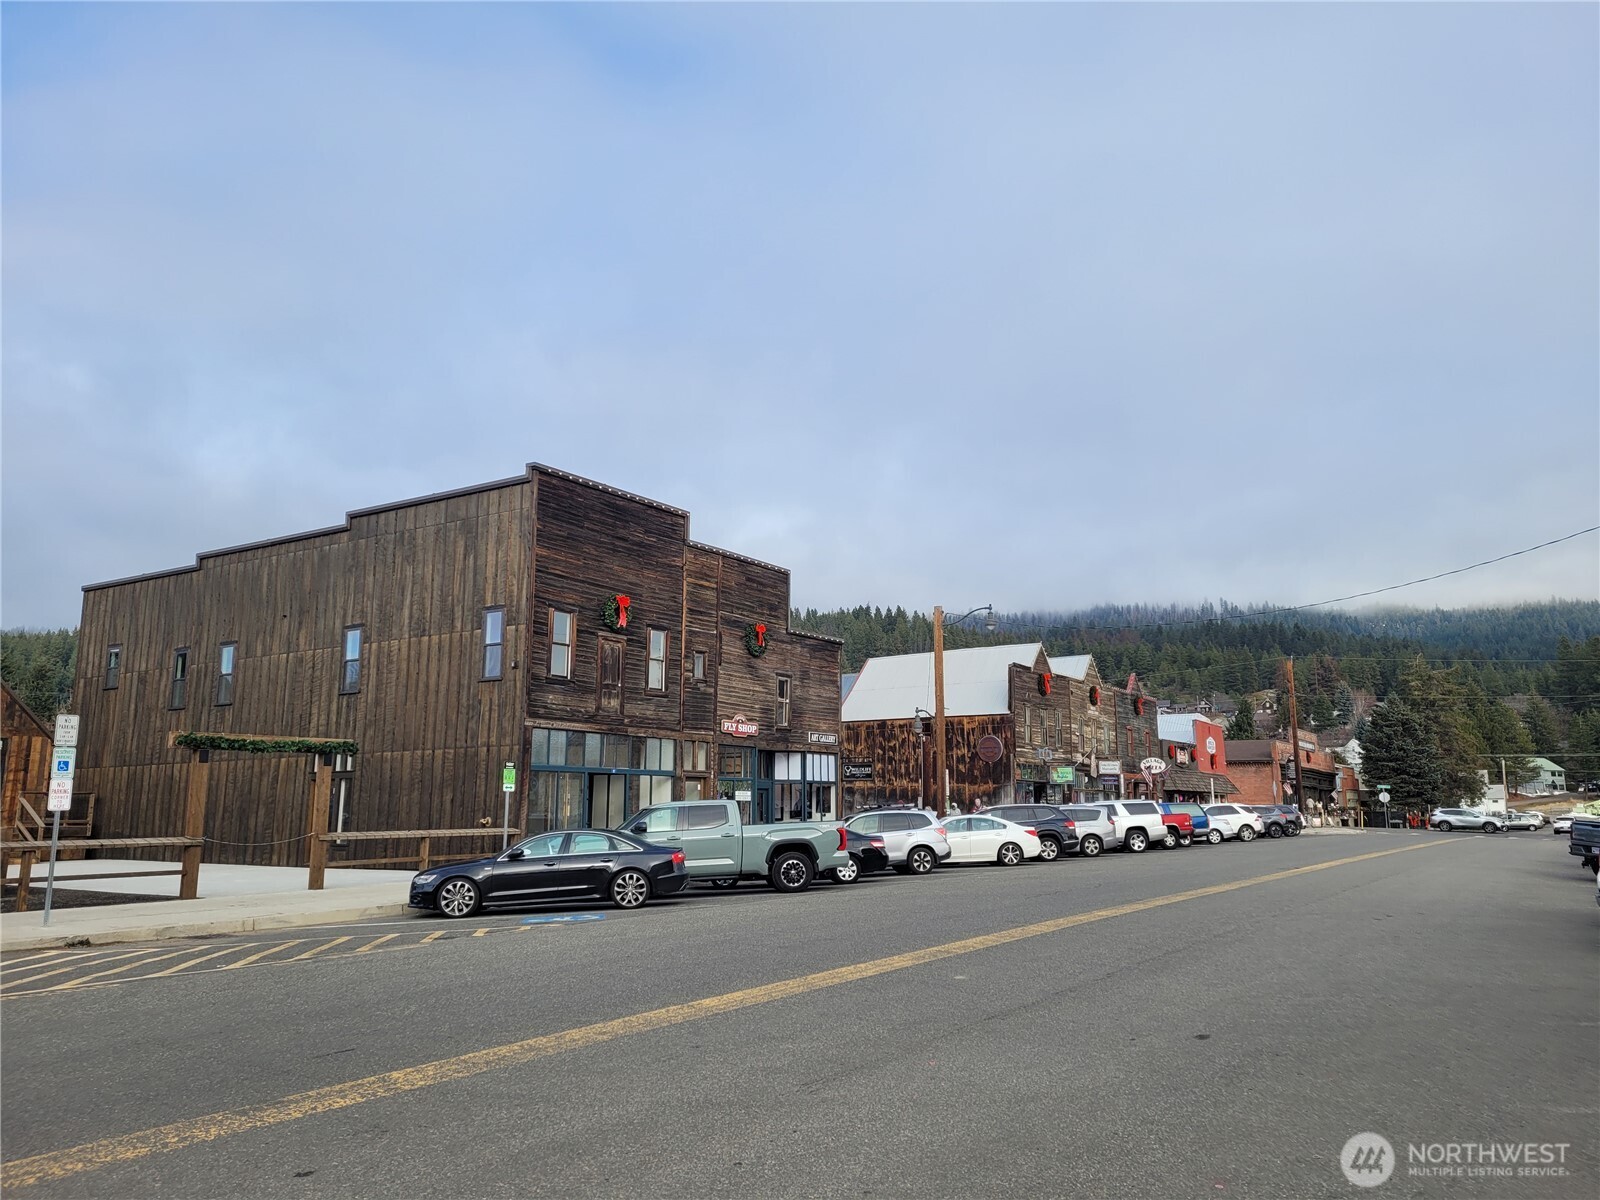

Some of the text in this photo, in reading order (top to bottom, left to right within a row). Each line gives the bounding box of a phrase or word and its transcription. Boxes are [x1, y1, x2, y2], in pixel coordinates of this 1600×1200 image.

[724, 722, 757, 733] FLY SHOP
[811, 733, 836, 743] ART GALLERY
[1142, 758, 1163, 766] VILLAGE
